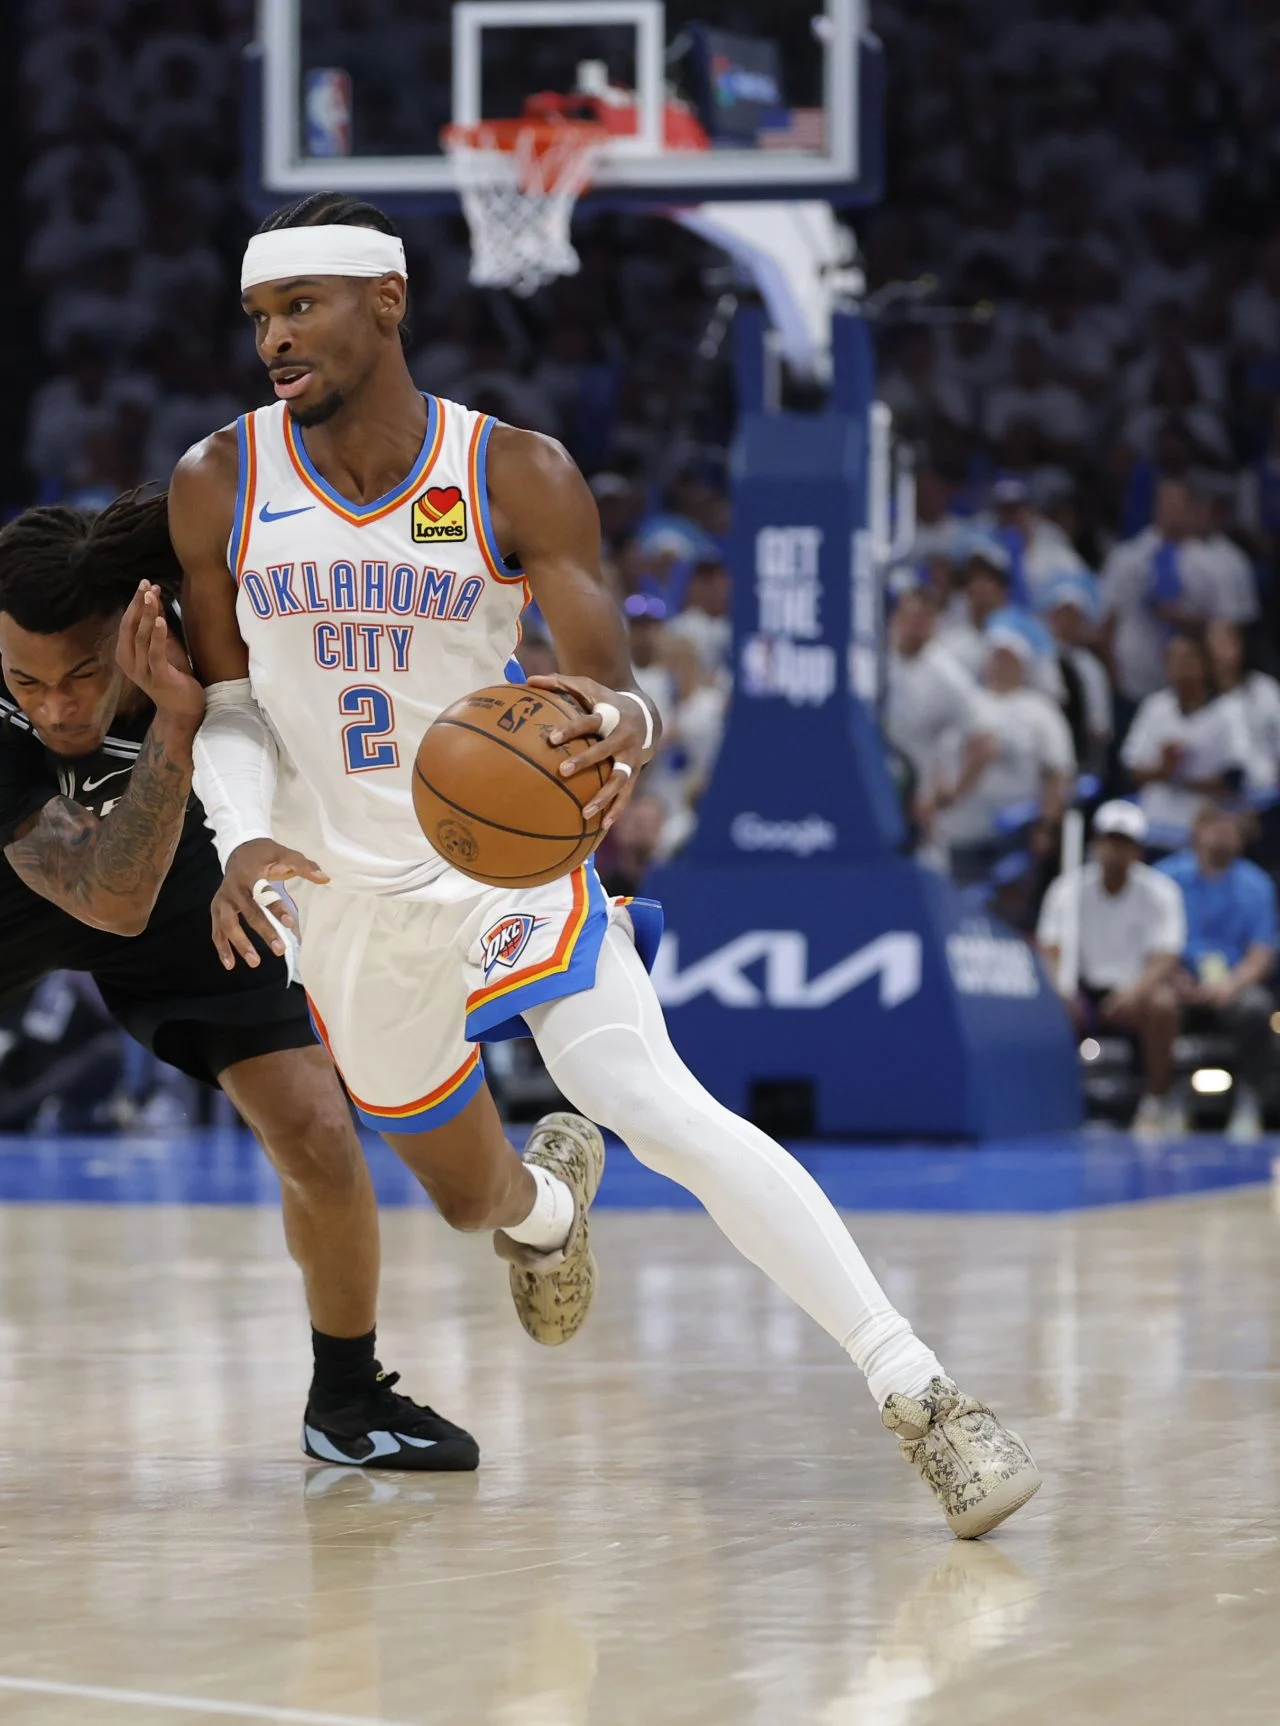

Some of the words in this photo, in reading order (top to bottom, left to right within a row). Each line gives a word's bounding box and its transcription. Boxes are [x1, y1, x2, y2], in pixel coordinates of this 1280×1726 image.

[755, 525, 824, 577] GET
[241, 559, 486, 622] OKLAHOMA
[754, 578, 824, 639] THE
[313, 621, 414, 672] CITY
[338, 684, 400, 775] 2
[729, 811, 839, 859] Google
[483, 919, 522, 973] OKC
